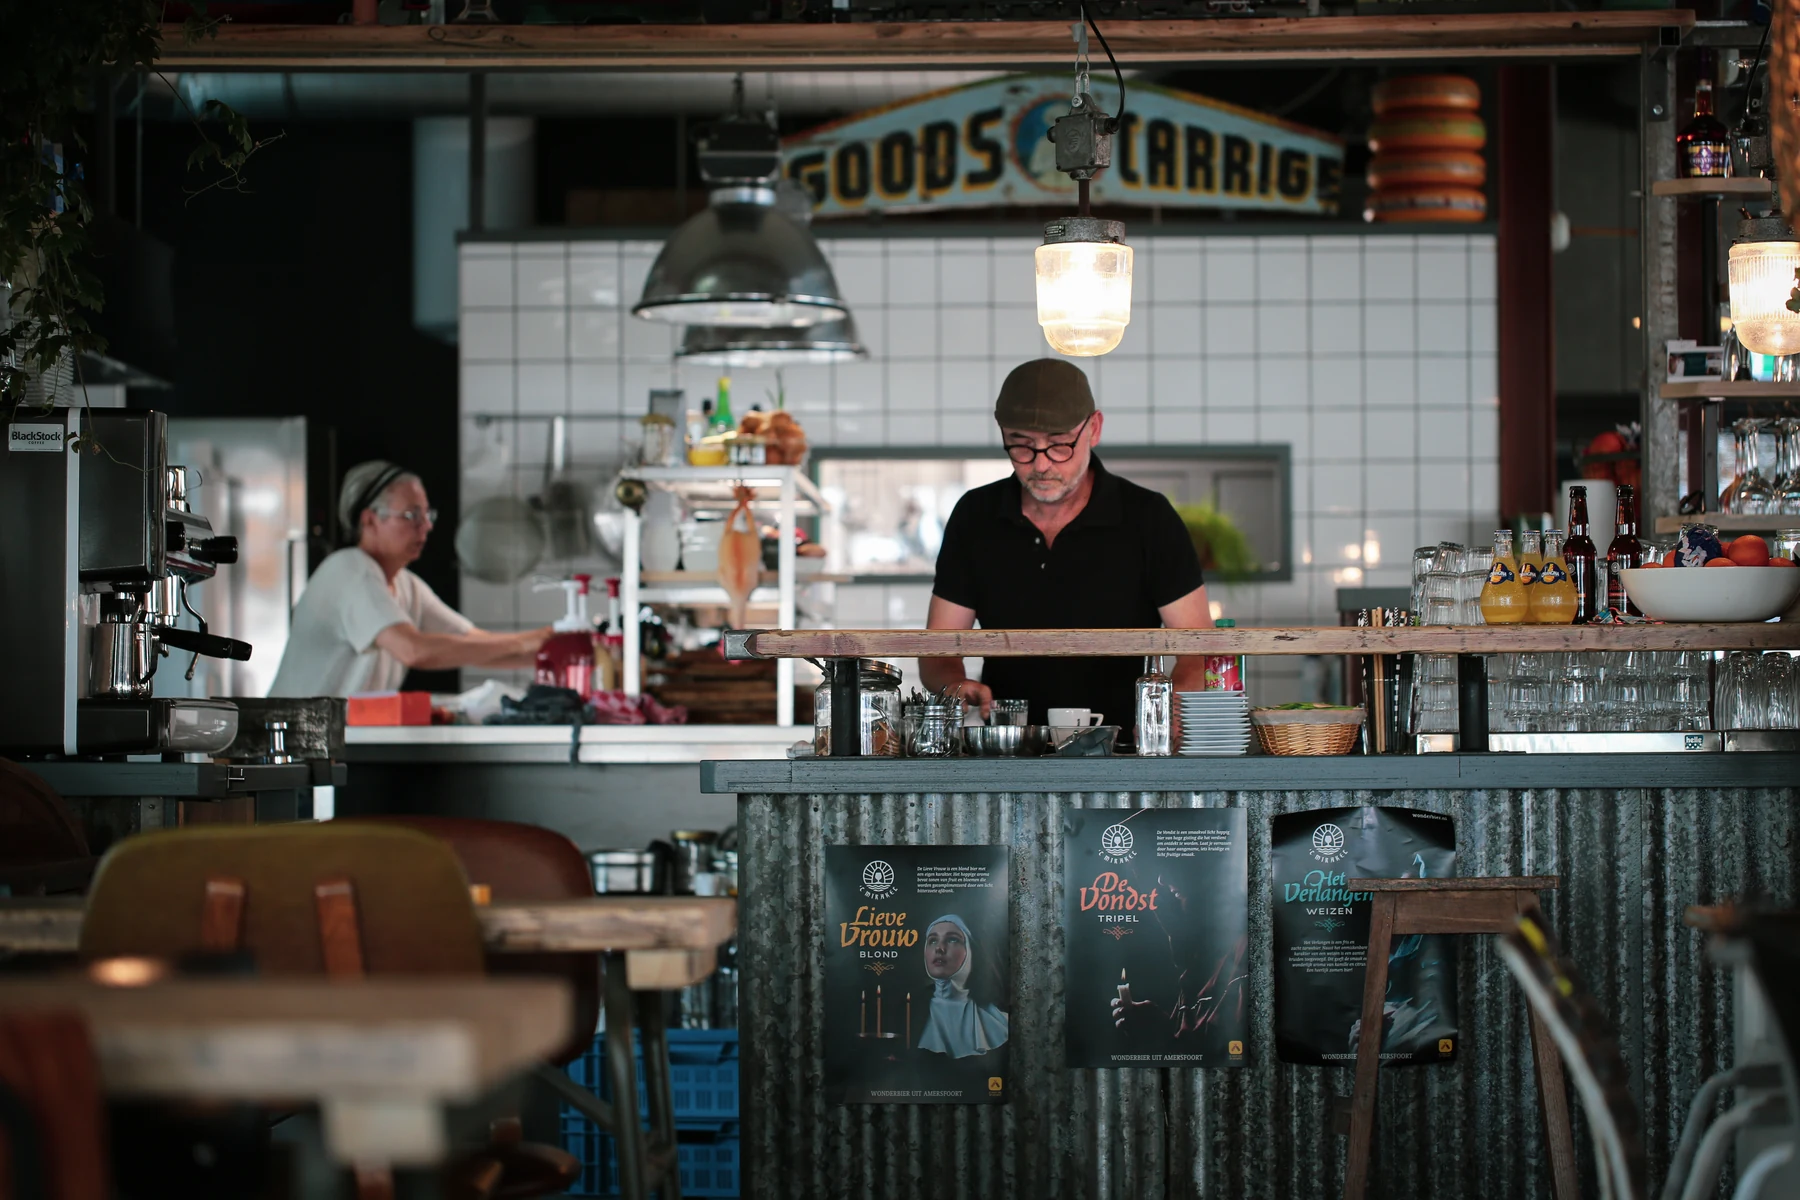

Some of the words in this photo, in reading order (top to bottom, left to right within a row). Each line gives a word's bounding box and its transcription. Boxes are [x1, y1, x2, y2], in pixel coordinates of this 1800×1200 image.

[783, 105, 1006, 211] GOODS
[12, 431, 61, 440] BlackStock
[1092, 872, 1128, 892] De
[1304, 870, 1346, 887] Het
[1080, 886, 1158, 911] Vondst
[849, 906, 906, 926] Lieve
[840, 922, 918, 948] Vrouw
